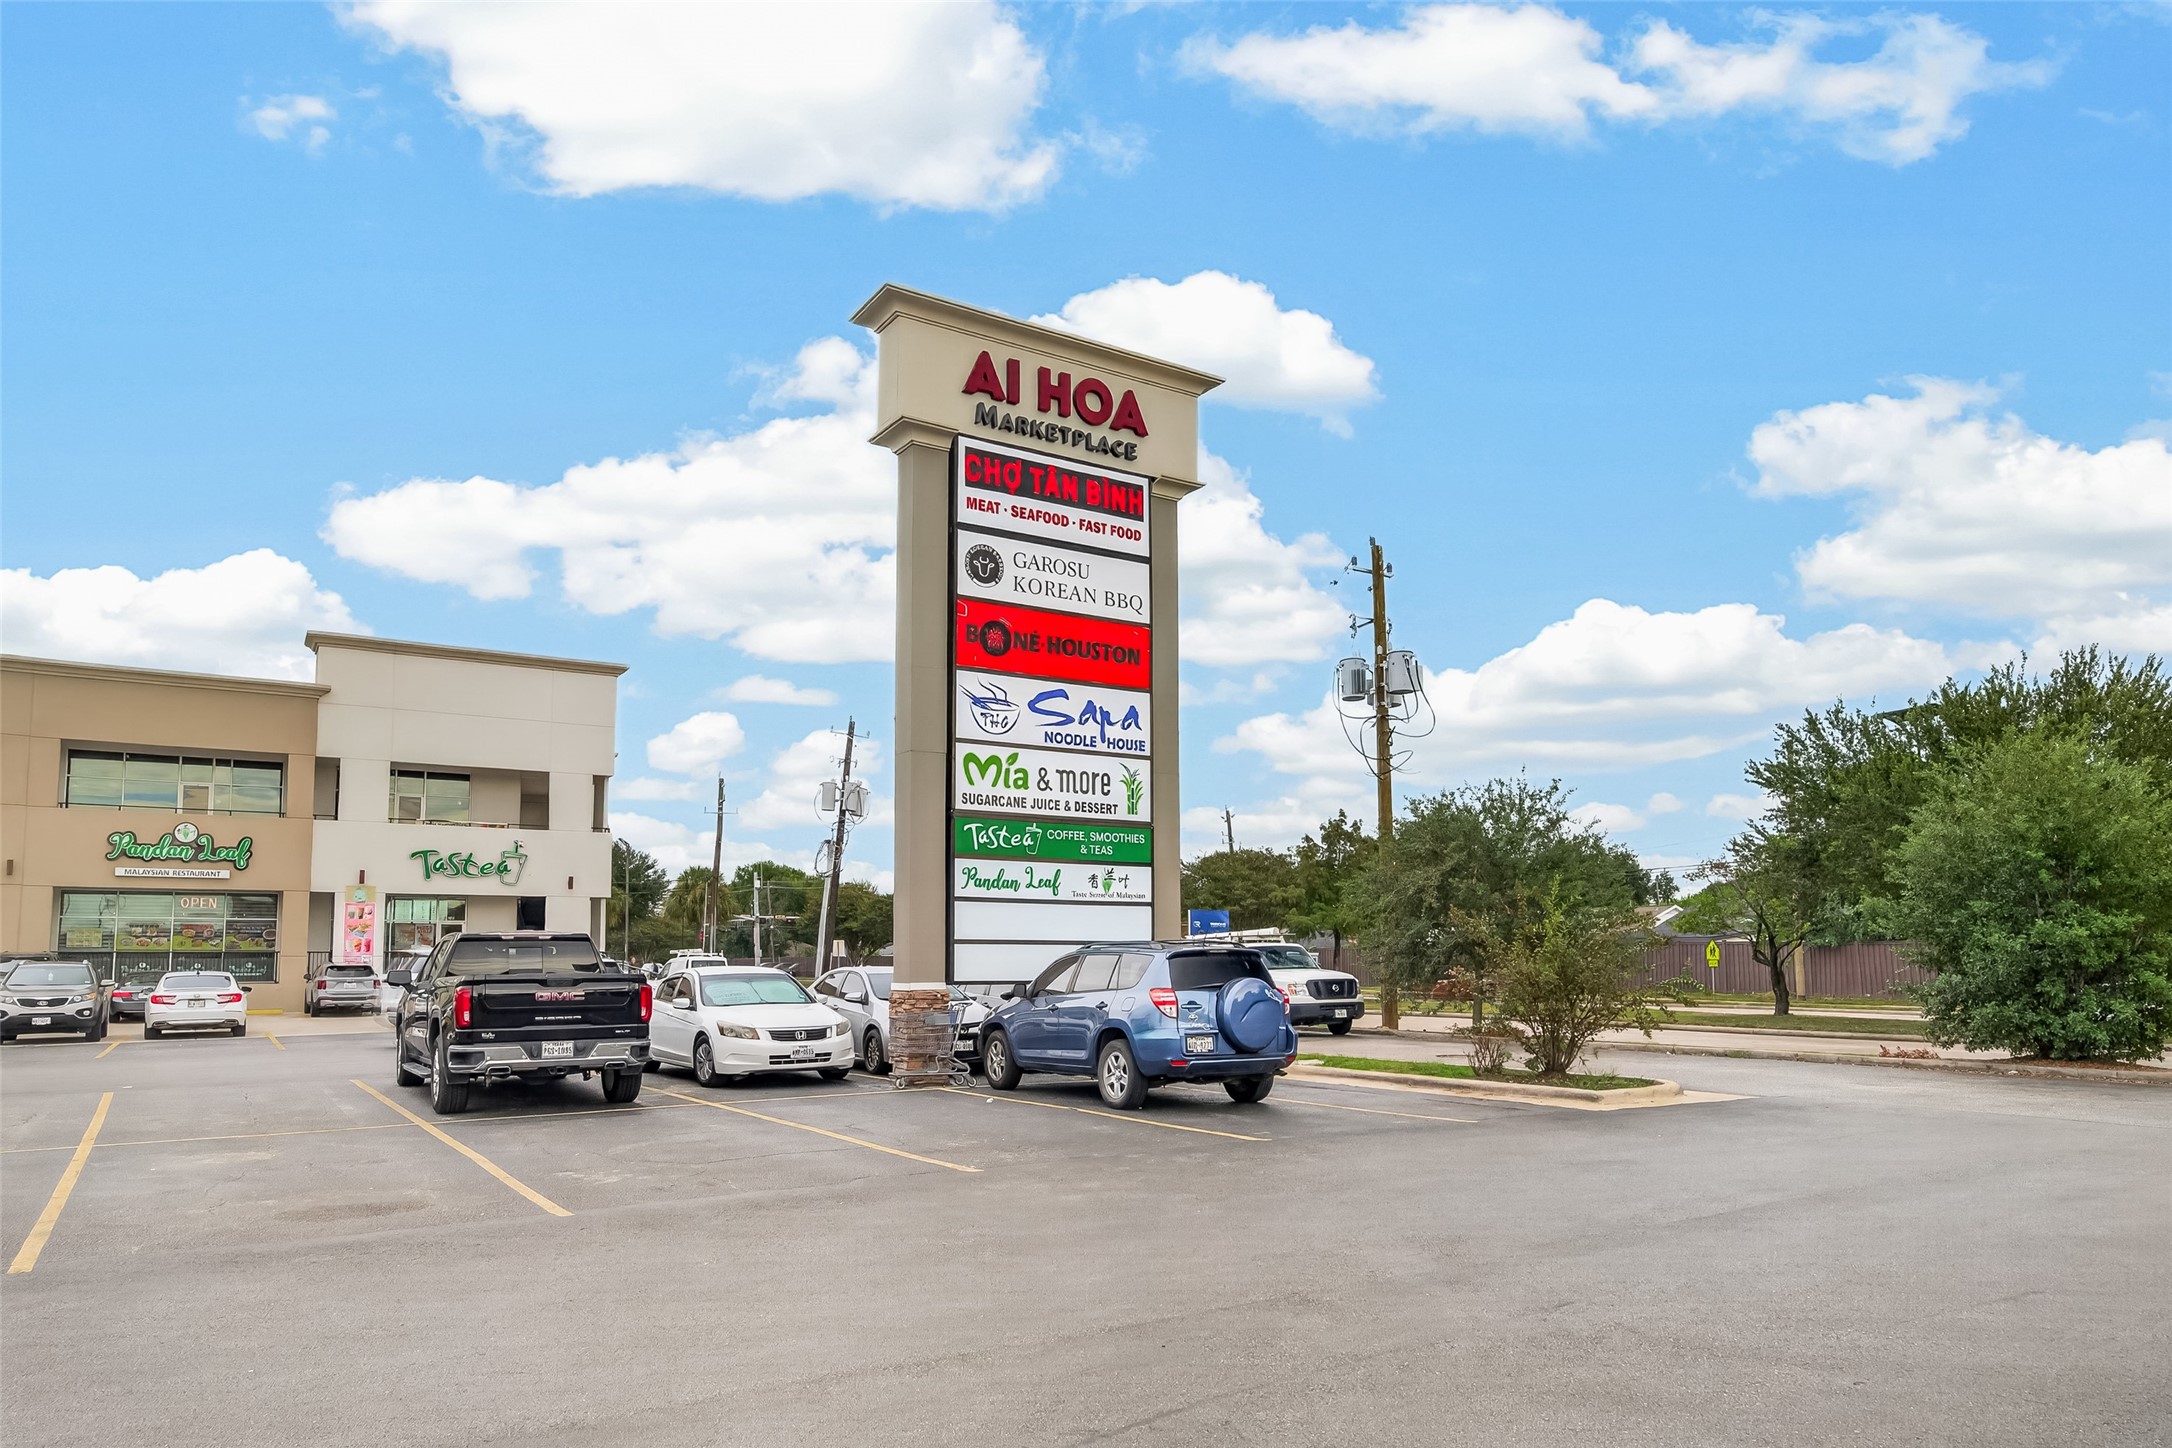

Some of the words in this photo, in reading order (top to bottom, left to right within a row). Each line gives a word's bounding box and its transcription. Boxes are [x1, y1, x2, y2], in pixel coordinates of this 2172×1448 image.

[961, 350, 1020, 405] AI
[1037, 366, 1149, 438] HOA
[974, 402, 1138, 462] MARKETPLACE
[1029, 465, 1079, 503] TÂN
[1086, 477, 1144, 517] BÌNH
[966, 497, 1001, 515] MEAT
[1010, 505, 1070, 528] SEAFOOD
[1079, 518, 1107, 535] FAST
[1110, 525, 1142, 542] FOOD
[1013, 552, 1090, 580] GAROSU
[1013, 576, 1097, 604] KOREAN
[1104, 591, 1143, 615] BBQ
[1047, 636, 1140, 666] HOUSTON
[1027, 688, 1142, 743] Sapa
[1044, 731, 1097, 748] NOODLE
[1107, 737, 1146, 752] HOUSE
[1037, 767, 1052, 791] &
[1056, 769, 1111, 796] more
[961, 792, 1027, 809] SUGARCANE
[1030, 798, 1060, 811] JUICE
[1064, 800, 1071, 811] &
[1075, 801, 1118, 815] DESSERT
[106, 832, 195, 862] Pandan
[198, 834, 252, 869] Leaf
[1047, 830, 1088, 842] COFFEE,
[1090, 831, 1145, 844] SMOOTHIES
[1080, 844, 1087, 854] &
[1089, 844, 1113, 855] TEAS
[124, 868, 170, 876] MALAYSIAN
[172, 869, 221, 878] RESTAURANT
[961, 866, 1021, 892] Pandan
[1025, 866, 1062, 896] Leaf
[180, 897, 217, 909] OPEN
[535, 991, 586, 1001] GMC
